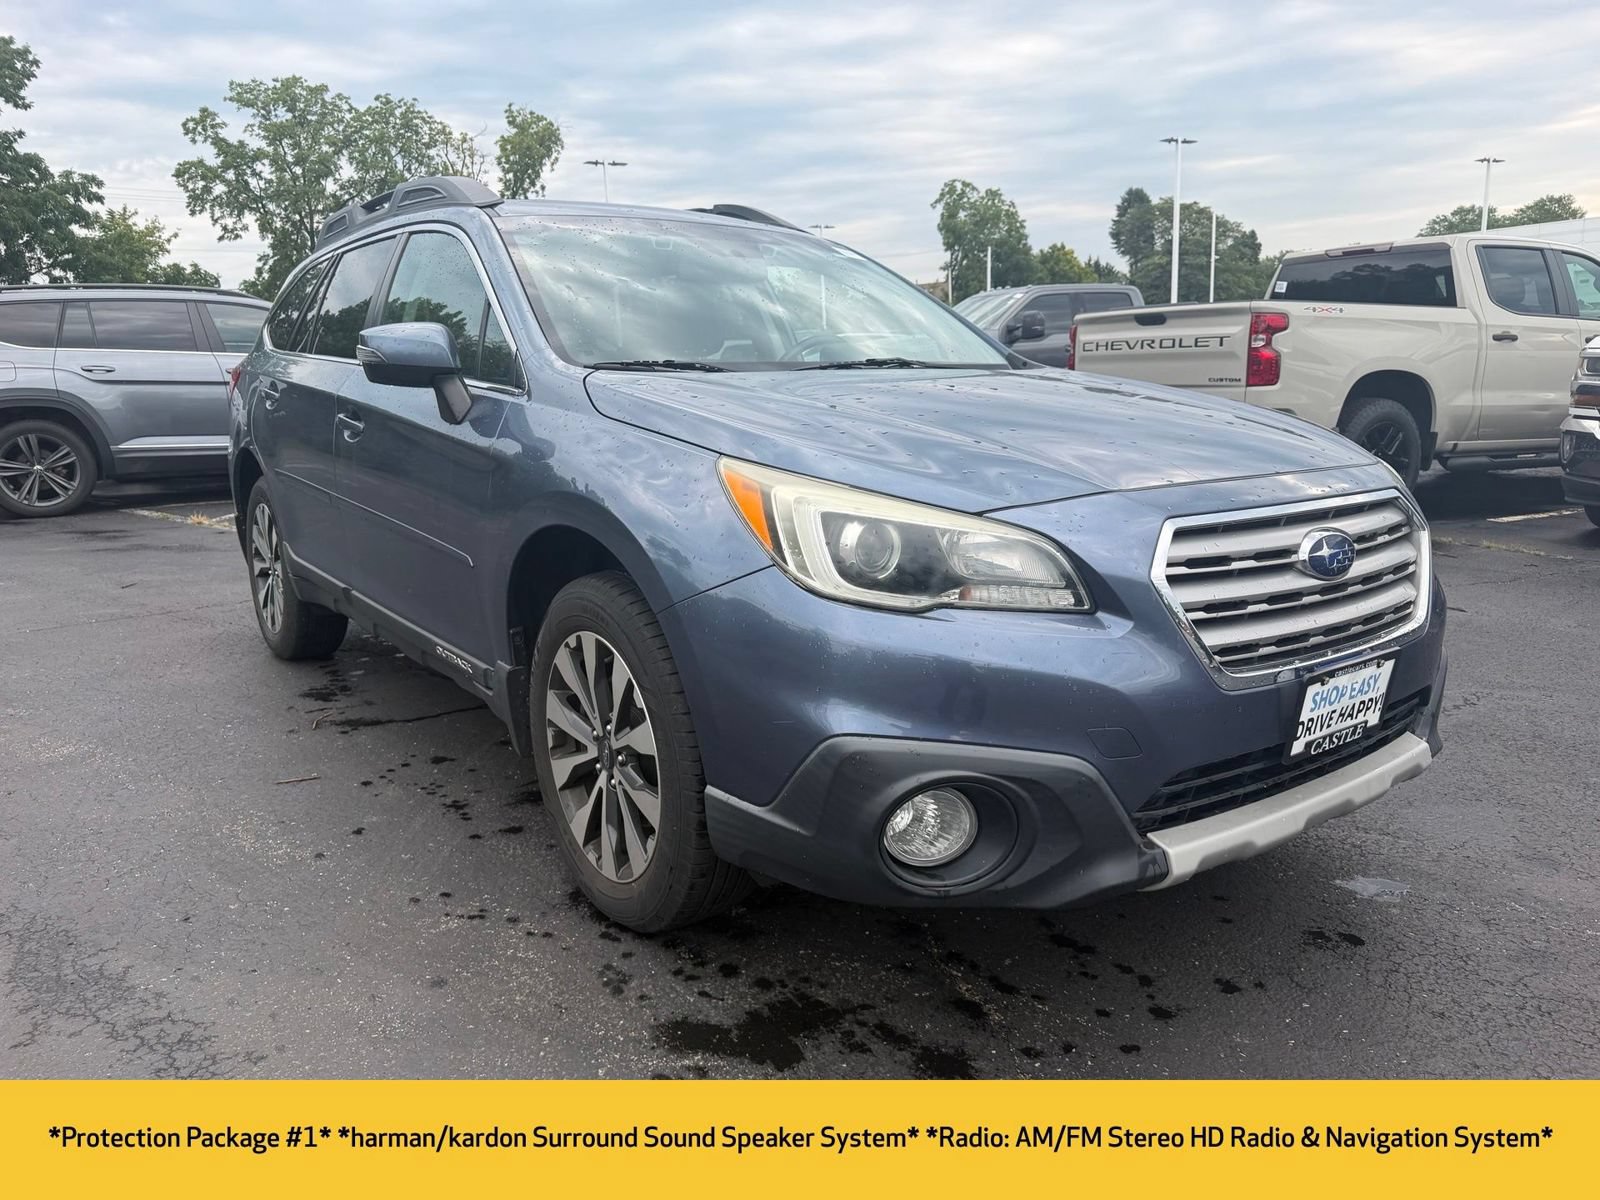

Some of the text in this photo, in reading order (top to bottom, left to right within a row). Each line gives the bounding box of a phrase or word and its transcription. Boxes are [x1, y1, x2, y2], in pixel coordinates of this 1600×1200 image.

[1082, 335, 1231, 352] CHEVROLET
[1310, 684, 1348, 712] SHOP
[1296, 692, 1384, 740] DRIVE HAPPY!
[1311, 724, 1365, 755] CASTLE
